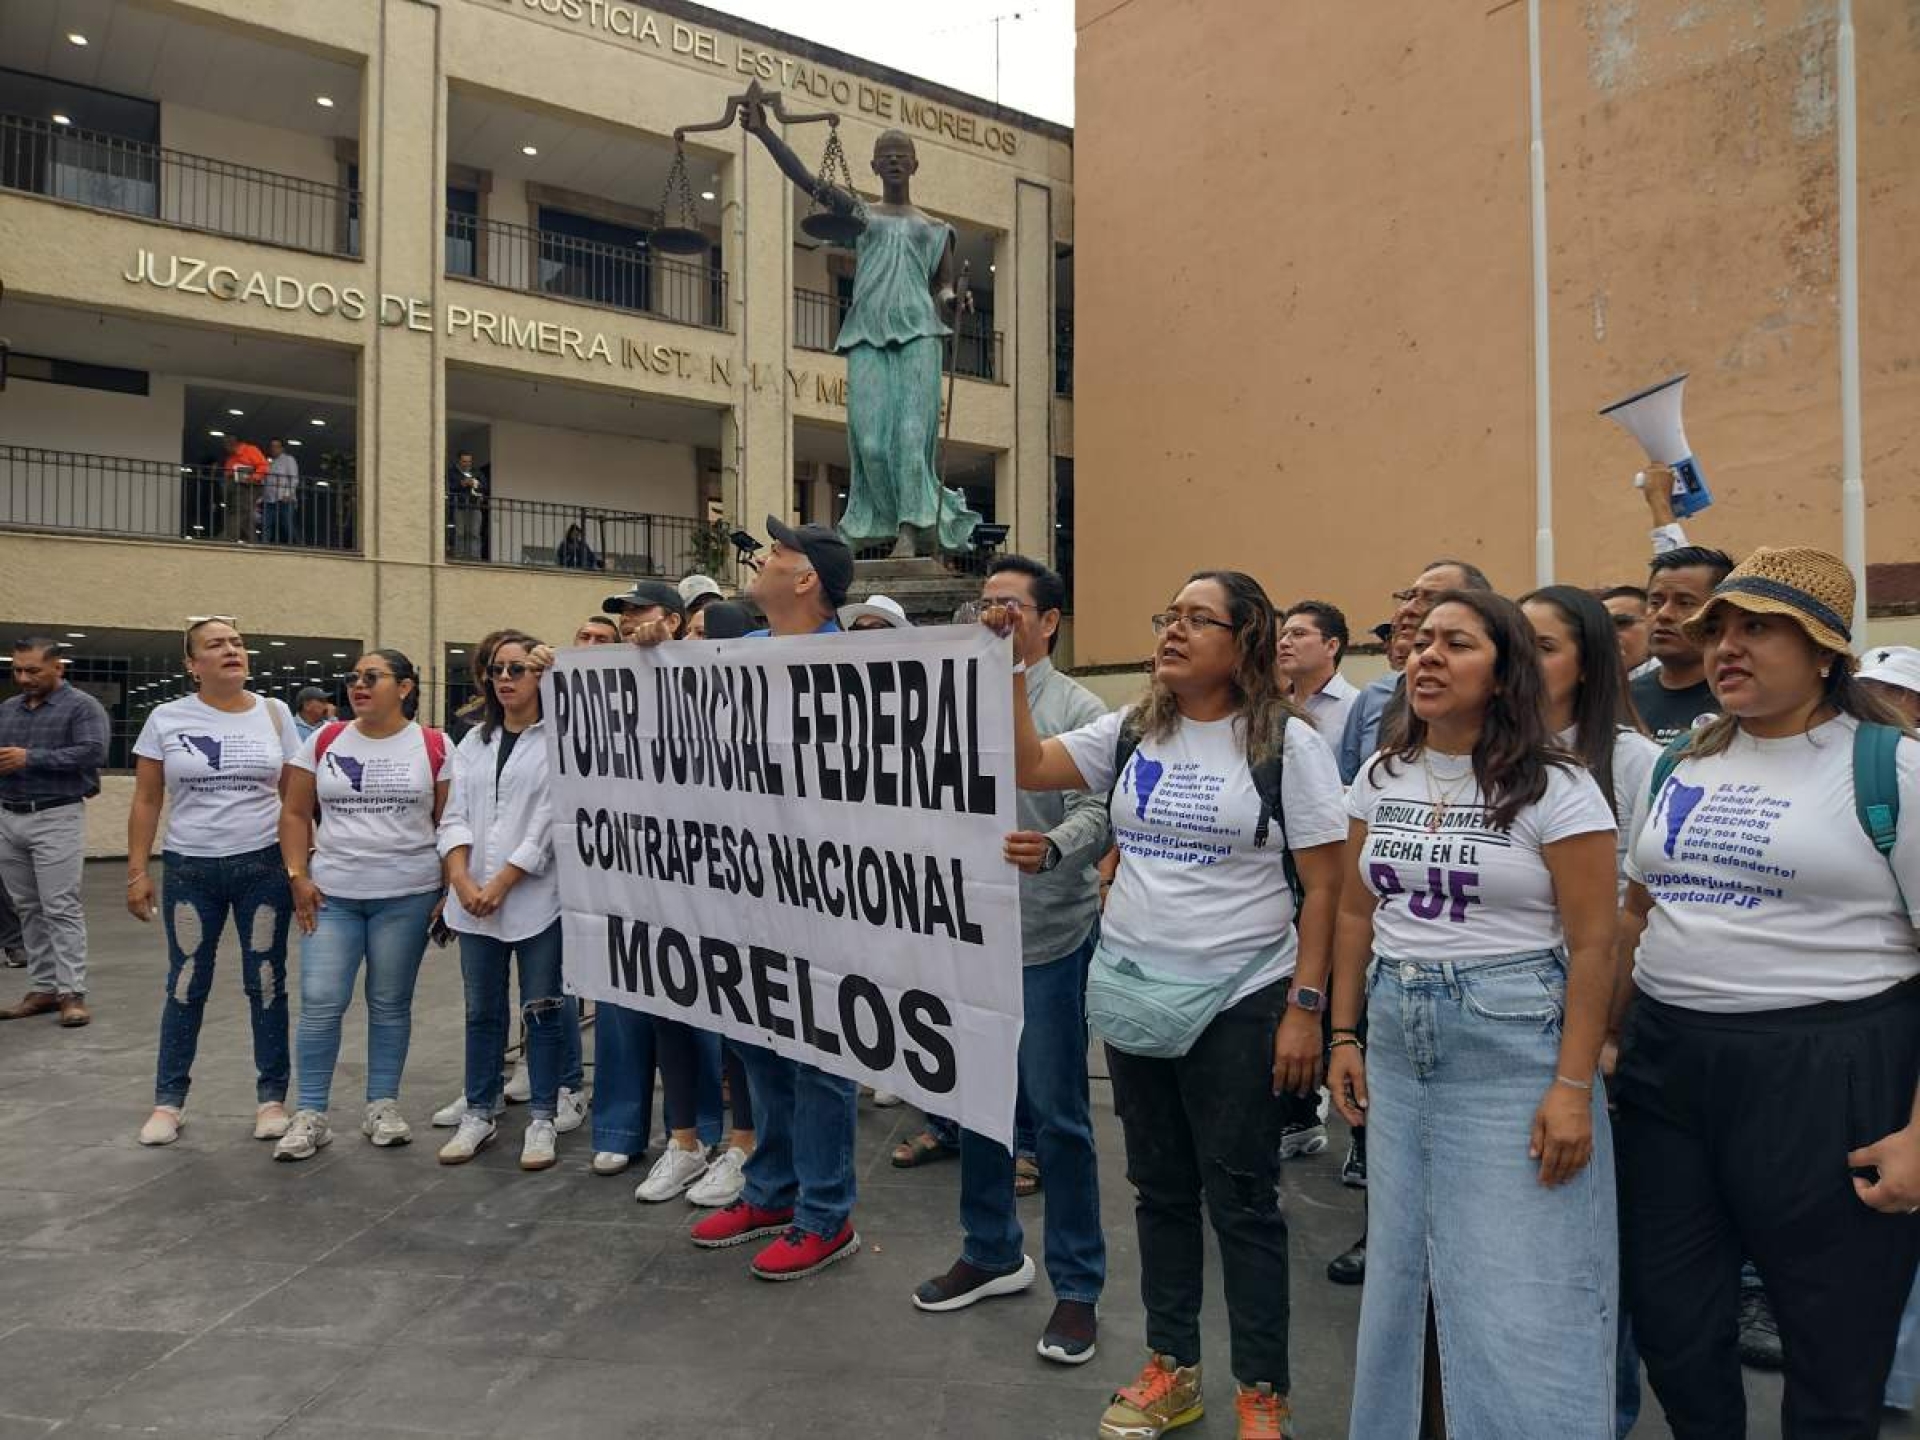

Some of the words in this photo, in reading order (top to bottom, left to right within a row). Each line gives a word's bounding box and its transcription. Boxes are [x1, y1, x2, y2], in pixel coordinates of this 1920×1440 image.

[672, 24, 728, 68] DEL
[735, 44, 850, 105] ESTADO
[858, 82, 893, 119] DE
[900, 95, 1018, 155] MORELOS
[124, 248, 367, 320] JUZGADOS
[379, 293, 434, 333] DE
[447, 304, 613, 365] PRIMERA
[786, 367, 808, 398] Y
[553, 666, 644, 780] PODER
[650, 664, 785, 796] JUDICIAL
[786, 657, 997, 815] FEDERAL
[1688, 826, 1712, 837] hoy
[1714, 829, 1737, 839] nos
[1741, 832, 1771, 845] toca
[1702, 804, 1757, 815] defender
[1760, 809, 1781, 820] tus
[576, 806, 764, 898] CONTRAPESO
[768, 832, 984, 945] NACIONAL
[1370, 837, 1423, 862] HECHA
[1430, 844, 1453, 864] EN
[1459, 845, 1480, 866] EL
[1681, 852, 1708, 863] para
[1683, 838, 1763, 858] defendernos
[1369, 862, 1482, 923] PJF
[607, 914, 958, 1094] MORELOS
